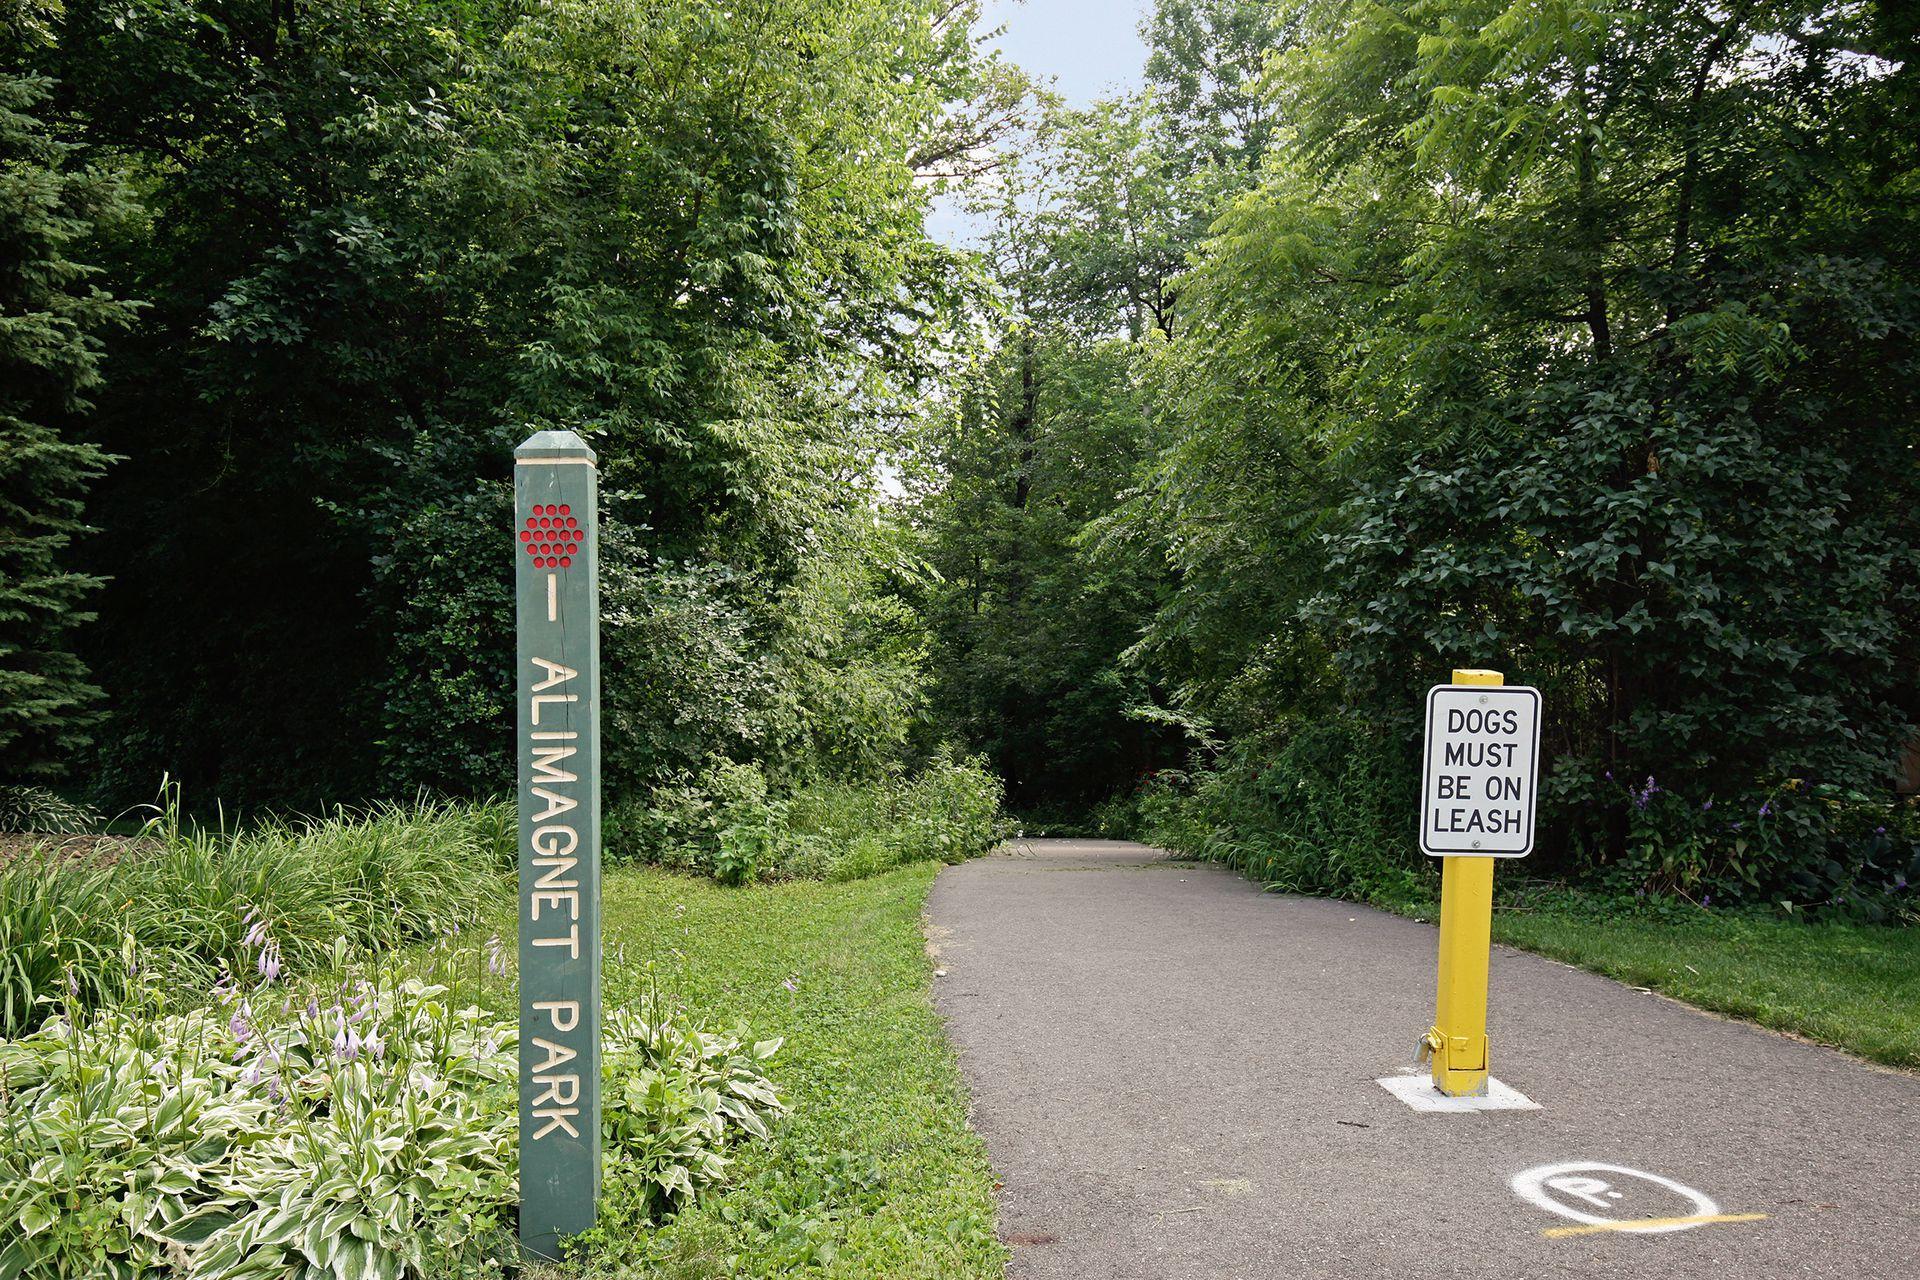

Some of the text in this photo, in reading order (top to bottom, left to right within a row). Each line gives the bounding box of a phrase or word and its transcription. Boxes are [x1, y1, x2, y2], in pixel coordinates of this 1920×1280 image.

[1448, 709, 1517, 734] DOGS
[1445, 742, 1517, 767] MUST
[1437, 775, 1521, 800] BE ON
[1434, 808, 1521, 833] LEASH
[531, 656, 580, 1140] ALIMAGNET PARK
